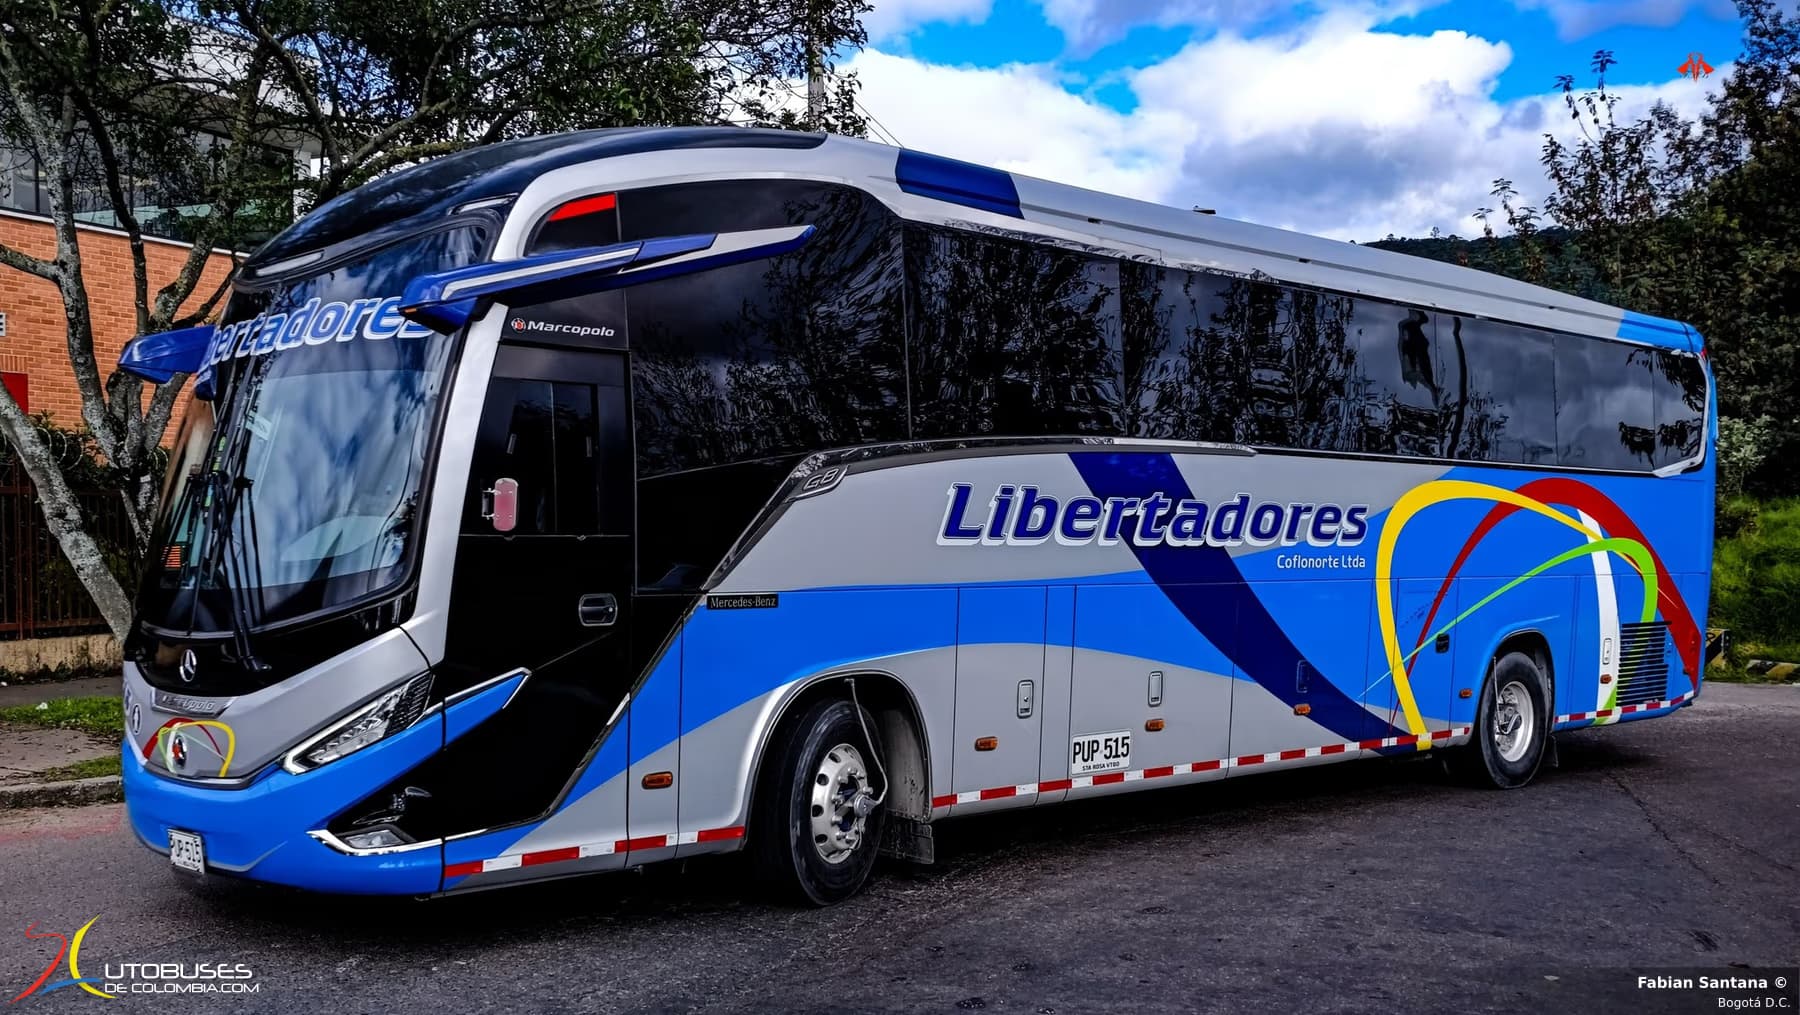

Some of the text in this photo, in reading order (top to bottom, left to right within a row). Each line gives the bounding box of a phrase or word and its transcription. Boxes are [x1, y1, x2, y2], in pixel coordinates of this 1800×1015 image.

[526, 320, 615, 337] Marcopolo
[936, 481, 1369, 547] Libertadores
[1276, 554, 1366, 569] Coflonorte Ltda
[710, 596, 777, 609] Mercedes-Benz
[1072, 736, 1130, 765] PUP 515
